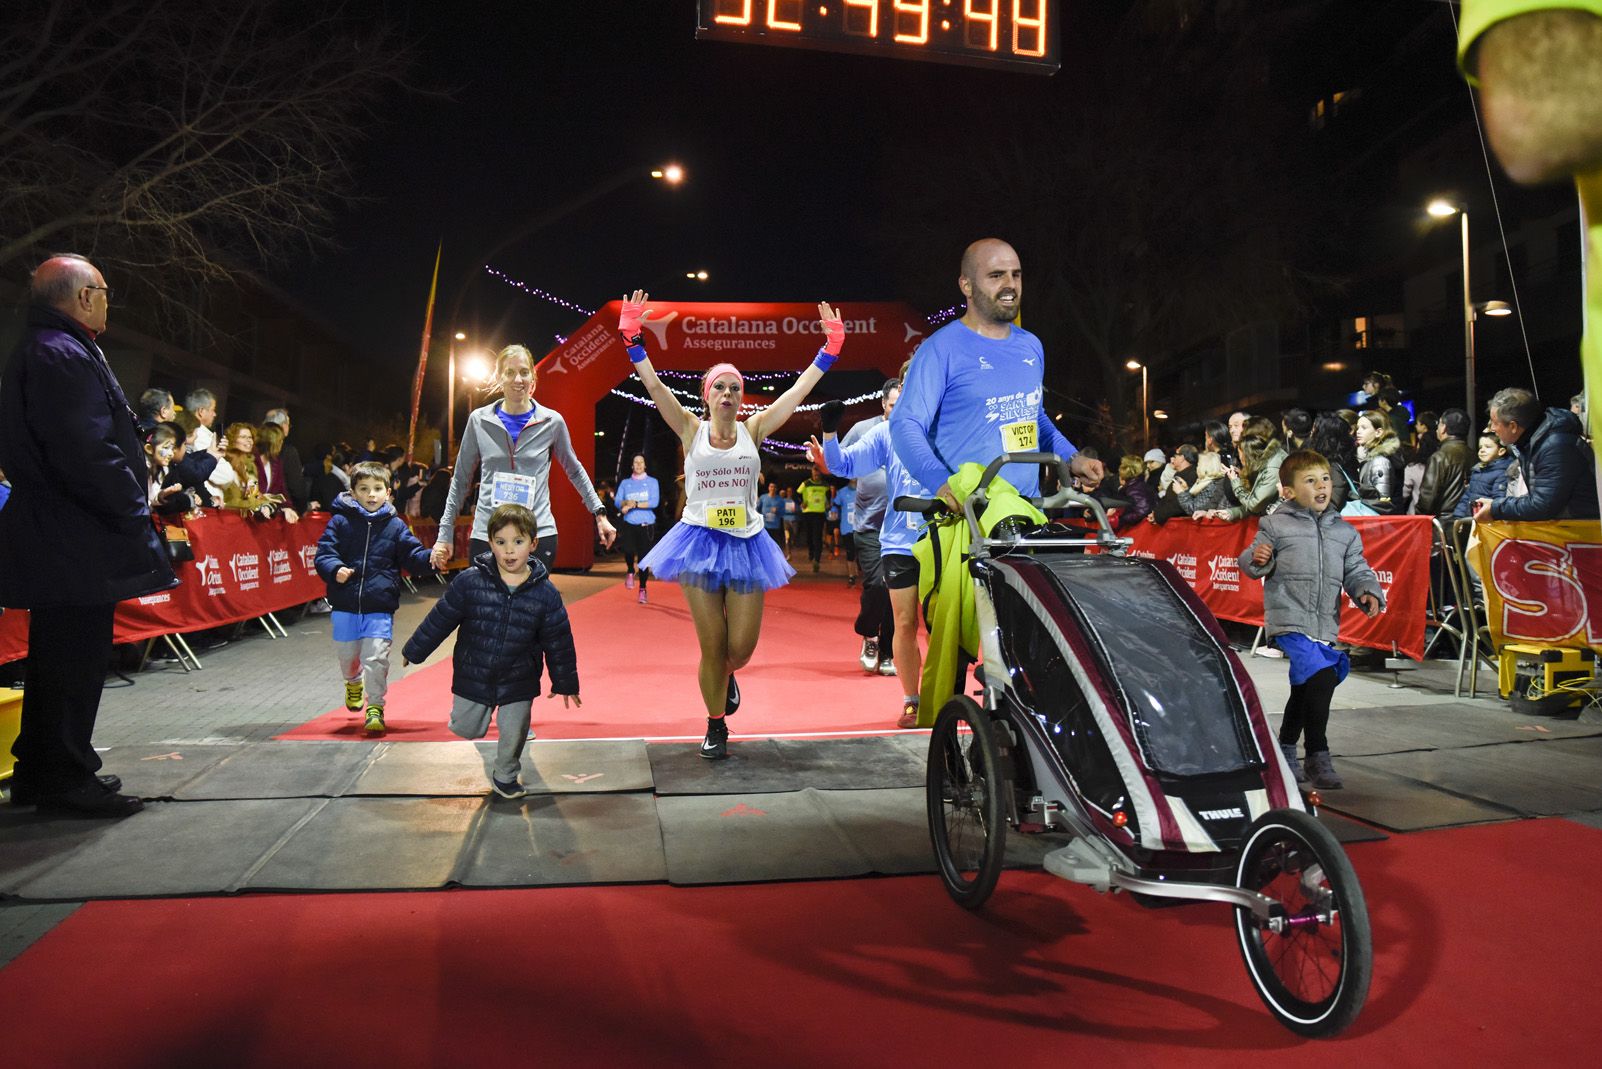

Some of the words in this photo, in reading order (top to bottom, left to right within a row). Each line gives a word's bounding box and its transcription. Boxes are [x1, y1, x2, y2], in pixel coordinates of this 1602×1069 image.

[682, 316, 778, 335] Catalana
[782, 316, 877, 335] Occent
[563, 324, 604, 358] Catalana
[569, 330, 611, 366] Occident
[683, 337, 776, 351] Assegurances
[985, 397, 997, 406] 20
[695, 469, 711, 479] Soy
[712, 467, 732, 477] Sólo
[734, 465, 751, 476] MÍA
[697, 479, 716, 491] ¡NO
[718, 480, 730, 488] es
[732, 478, 749, 488] NO!
[716, 508, 736, 517] PATI
[718, 517, 735, 526] 196
[1198, 807, 1245, 821] THULE
